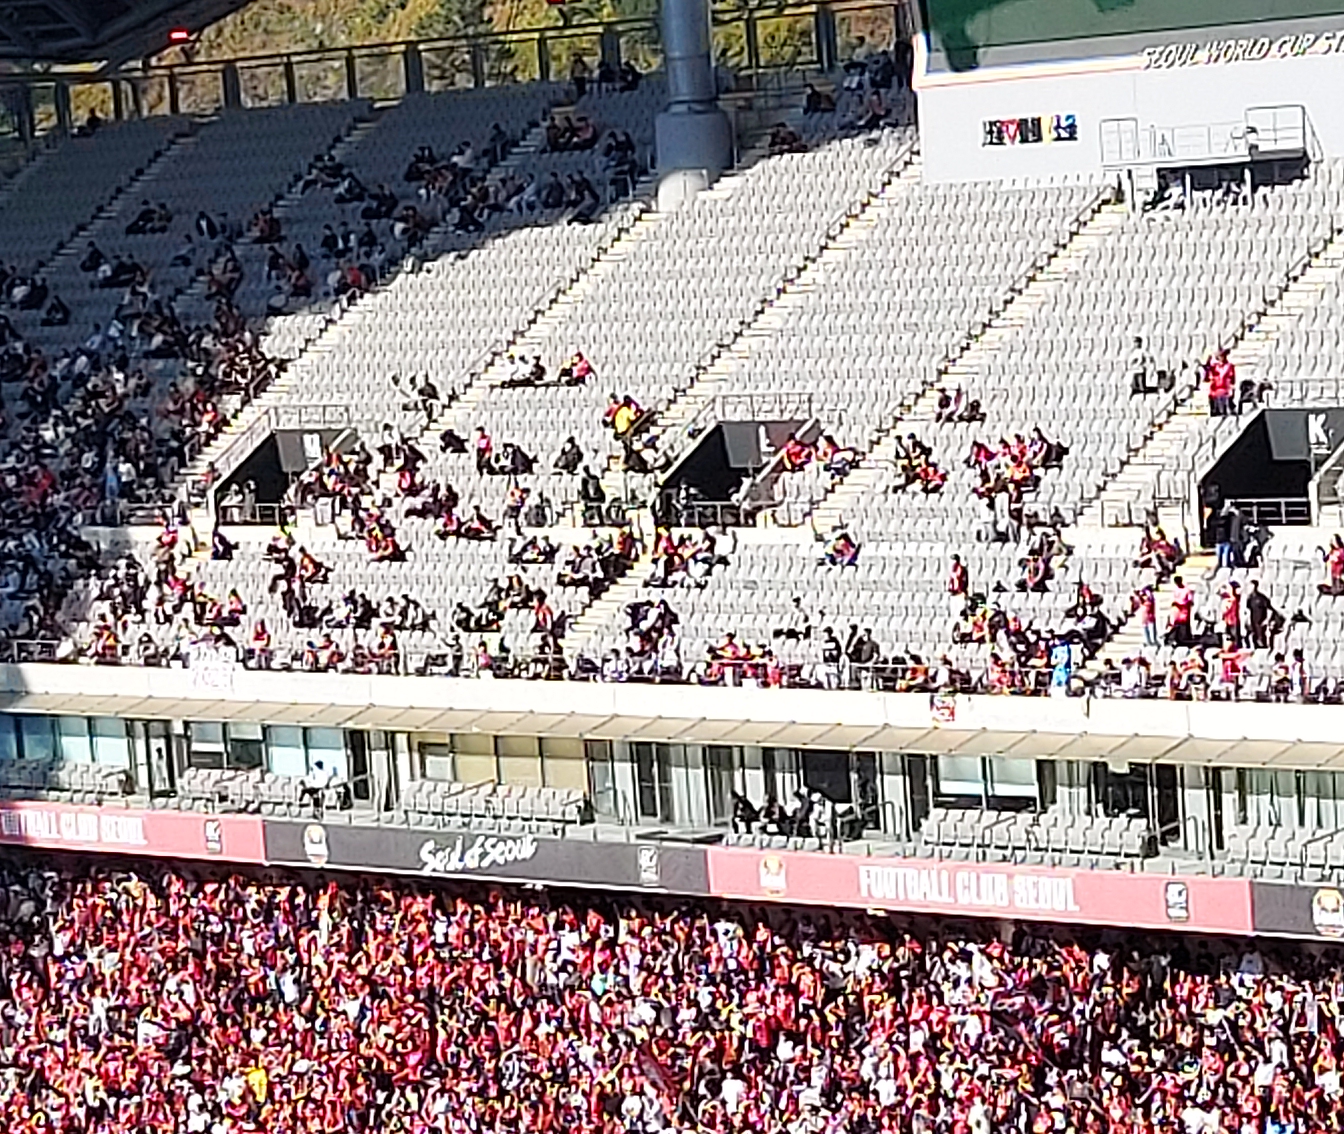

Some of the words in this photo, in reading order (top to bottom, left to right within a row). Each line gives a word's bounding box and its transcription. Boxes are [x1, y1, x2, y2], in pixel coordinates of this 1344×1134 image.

[1142, 43, 1199, 71] SEOUL
[1205, 37, 1271, 66] WORLD
[1276, 33, 1317, 60] CUP
[1308, 413, 1329, 444] K
[858, 864, 955, 905] FOOTBALL
[956, 871, 1011, 908] CLUB
[1013, 874, 1080, 913] SEOUL
